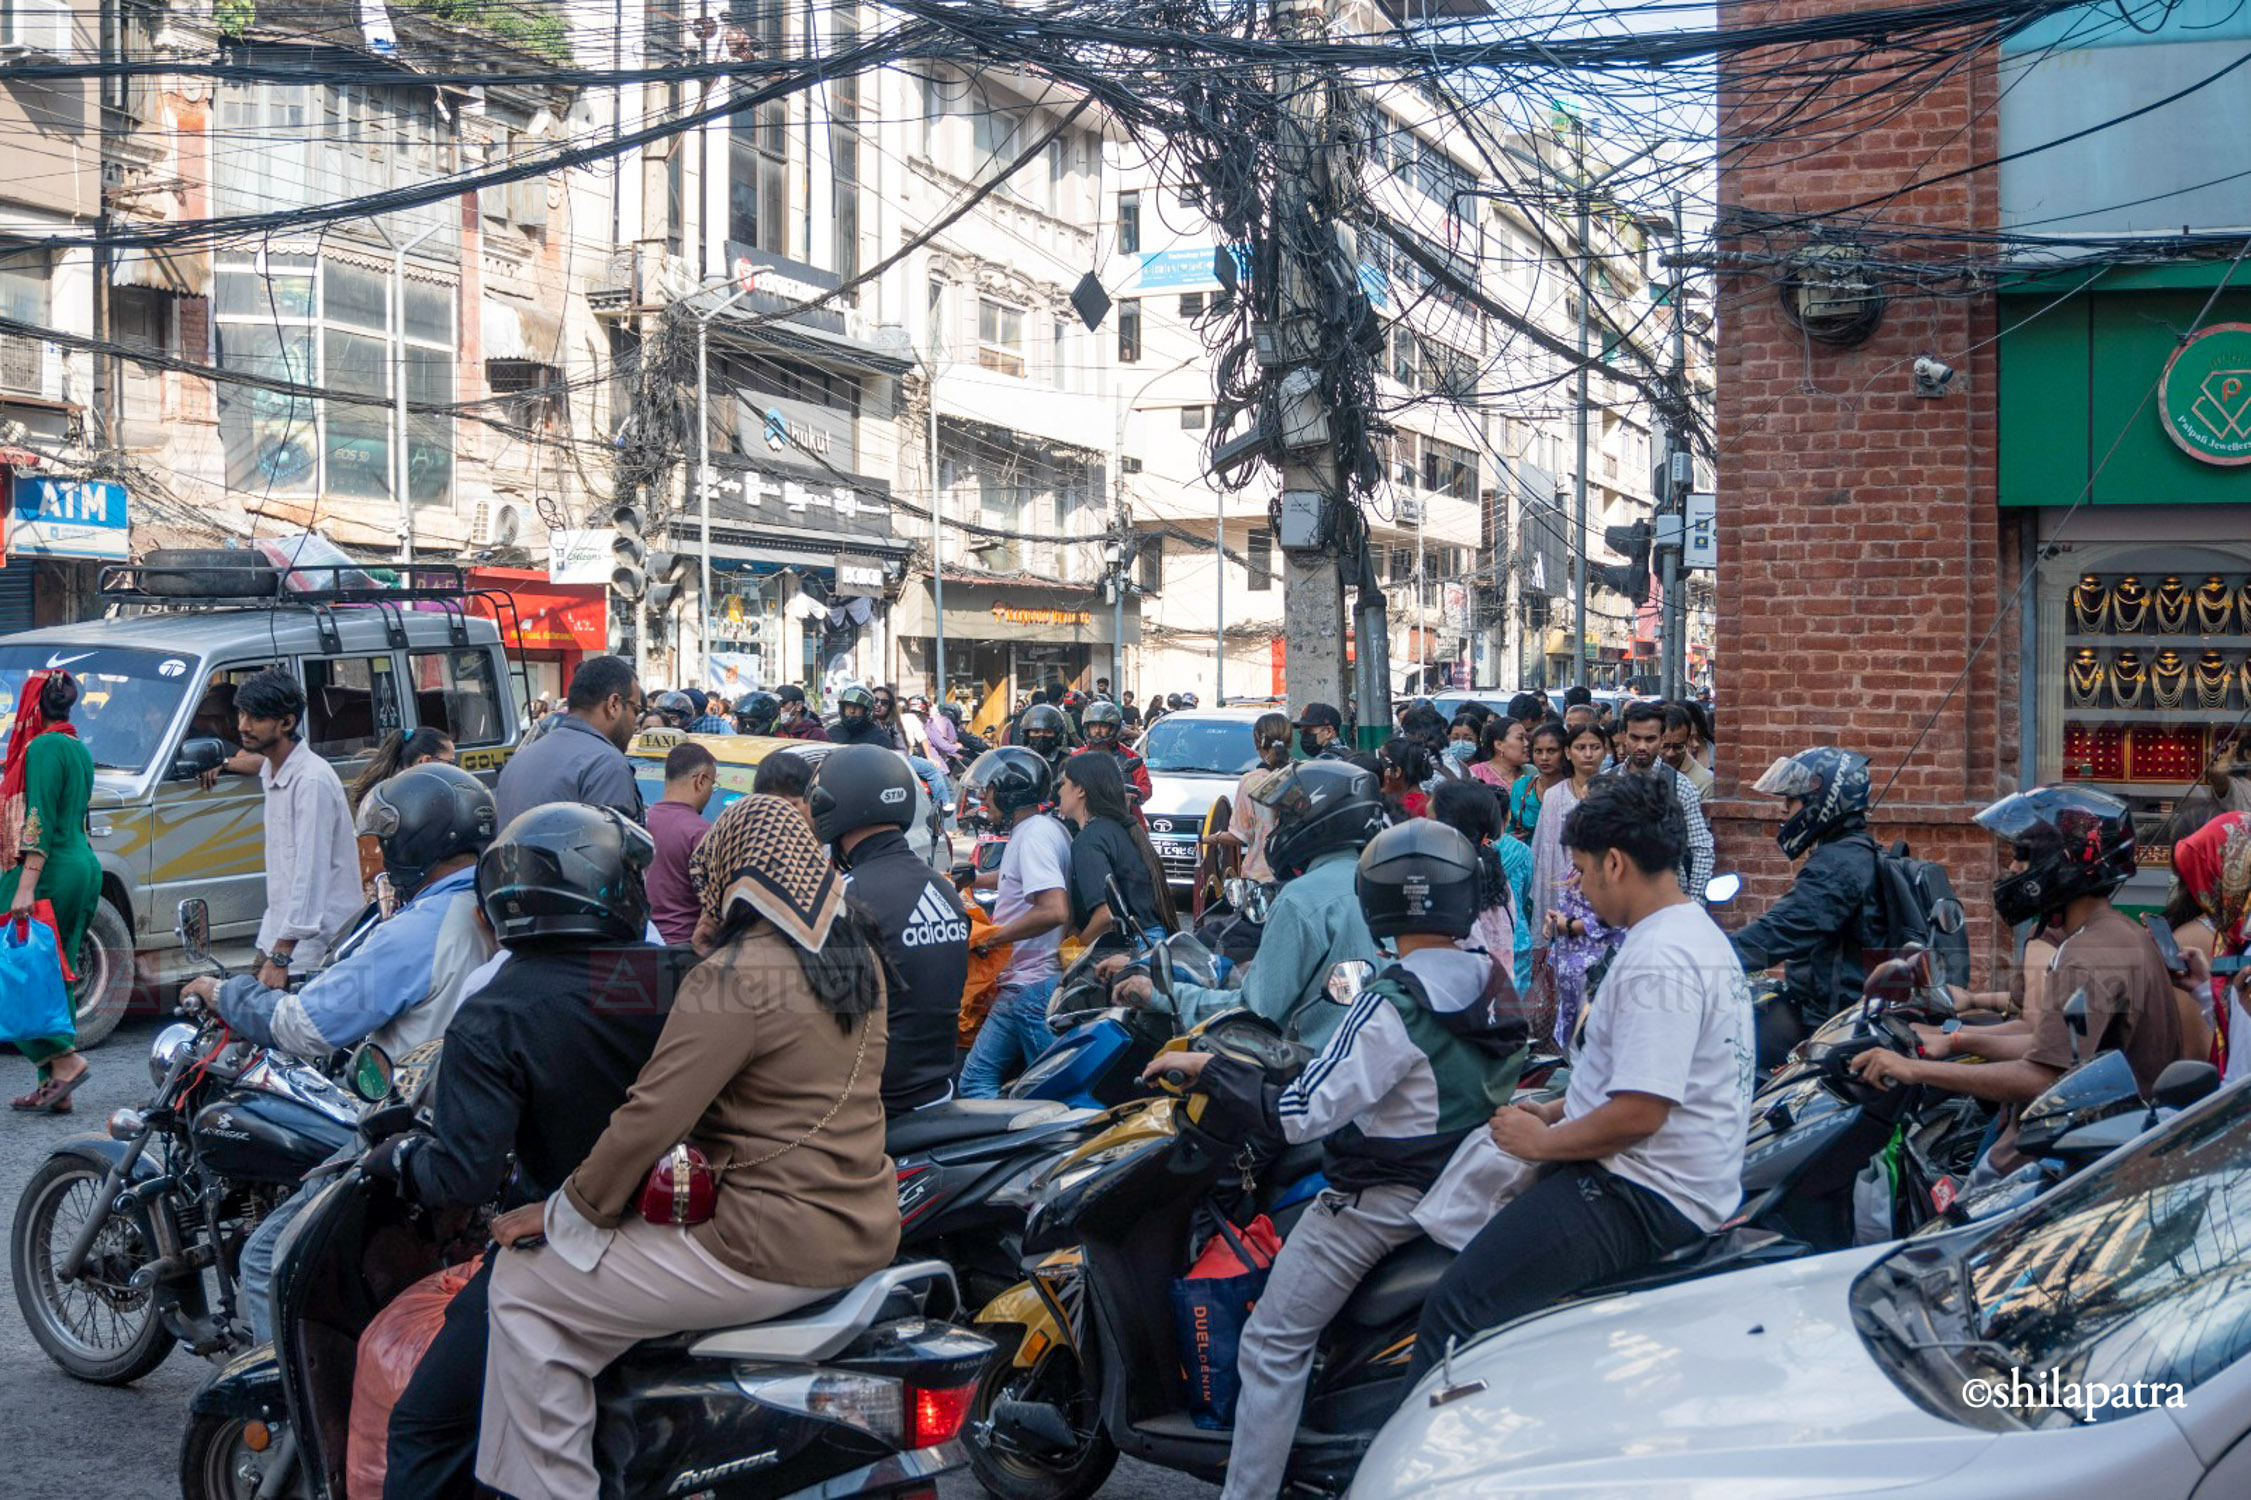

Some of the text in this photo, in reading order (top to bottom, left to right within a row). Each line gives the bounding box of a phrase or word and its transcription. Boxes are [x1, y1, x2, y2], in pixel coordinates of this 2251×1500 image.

[790, 421, 831, 454] hukut
[2177, 415, 2208, 444] Palpali
[39, 481, 107, 521] ATM
[643, 734, 677, 747] TAXI
[884, 789, 905, 800] STM
[1817, 753, 1853, 823] THUNDER
[902, 920, 968, 947] adidas
[1193, 1305, 1209, 1353] DUEL
[667, 1448, 779, 1495] AVIATOR
